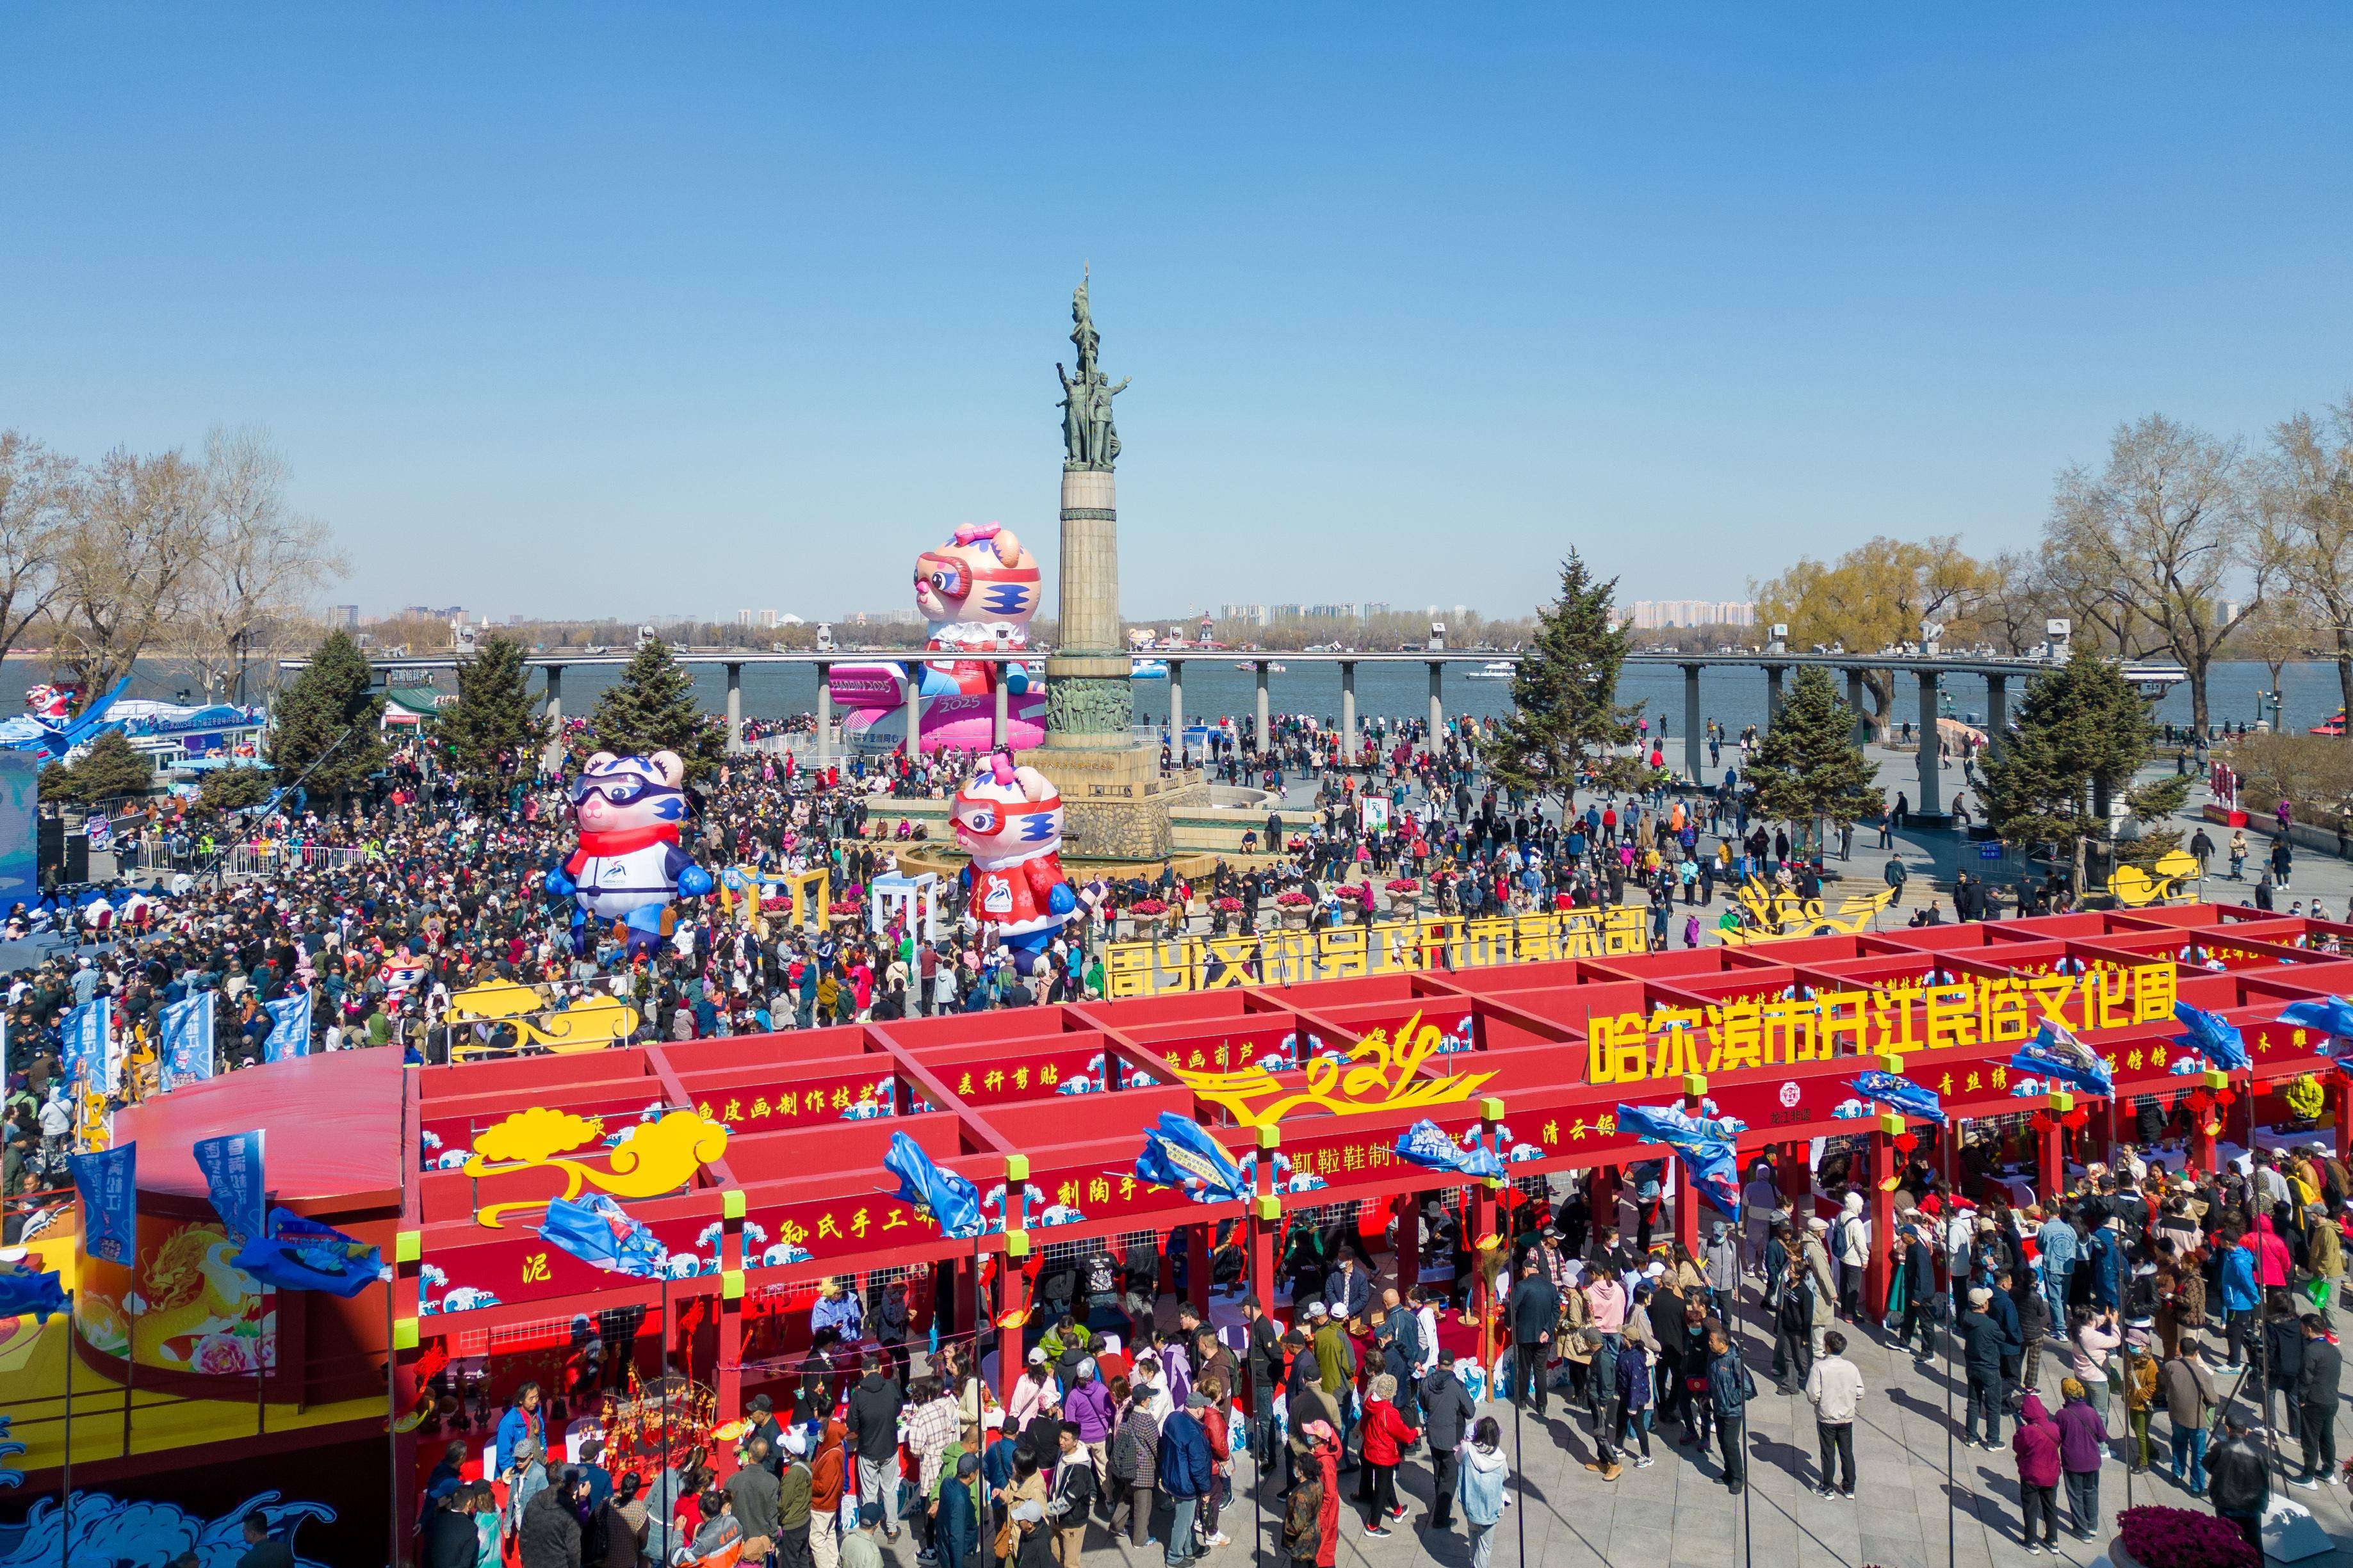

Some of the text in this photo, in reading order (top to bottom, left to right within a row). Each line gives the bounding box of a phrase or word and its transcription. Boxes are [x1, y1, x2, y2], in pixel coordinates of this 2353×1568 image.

[867, 681, 892, 693] 2025
[940, 697, 981, 713] 2025
[870, 734, 899, 743] 亚洲同心
[1589, 962, 2176, 1083] 哈尔滨市开江民俗文化周
[2258, 1029, 2307, 1054] 木雕
[958, 1063, 1059, 1095] 麦秆剪贴
[1937, 1066, 2008, 1097] 青丝绣
[698, 1083, 878, 1122] 鱼皮画制作技艺
[1770, 1108, 1811, 1124] 龙江非遗
